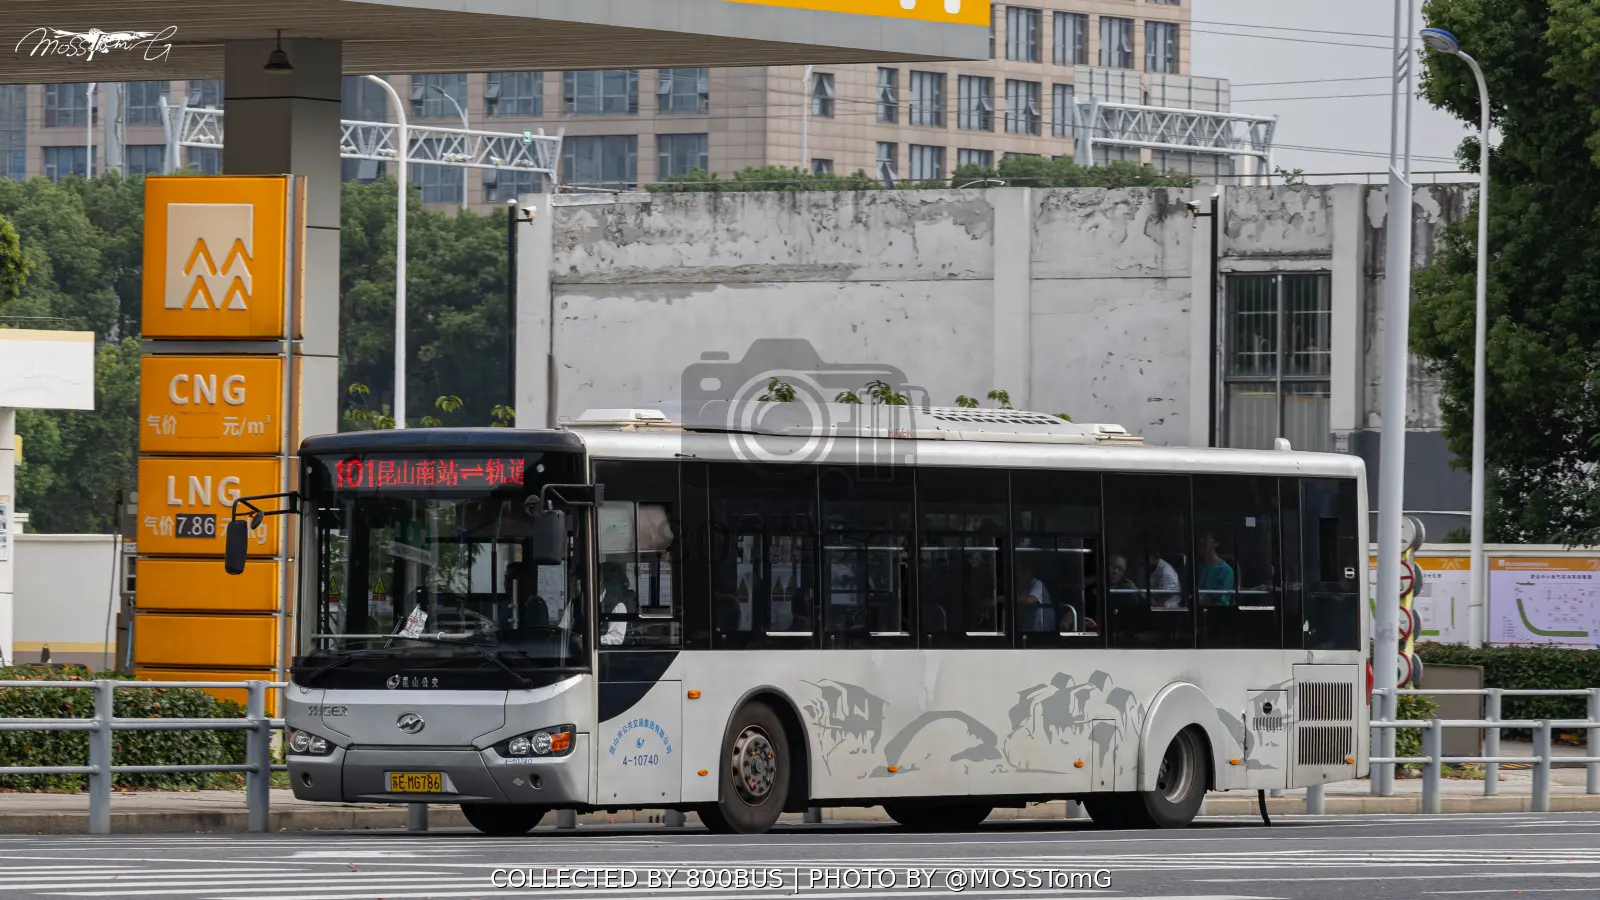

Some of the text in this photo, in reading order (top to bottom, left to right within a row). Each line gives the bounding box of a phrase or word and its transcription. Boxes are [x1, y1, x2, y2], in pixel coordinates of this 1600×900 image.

[168, 374, 246, 405] CNG
[147, 414, 177, 435] 气价
[335, 458, 374, 488] 101
[378, 459, 458, 486] 昆山南站
[167, 475, 241, 507] LNG
[144, 516, 175, 536] 气价
[176, 516, 215, 535] 7.86
[402, 676, 439, 688] 昆山公交
[308, 705, 348, 717] HIGER
[622, 754, 659, 767] 4-10740
